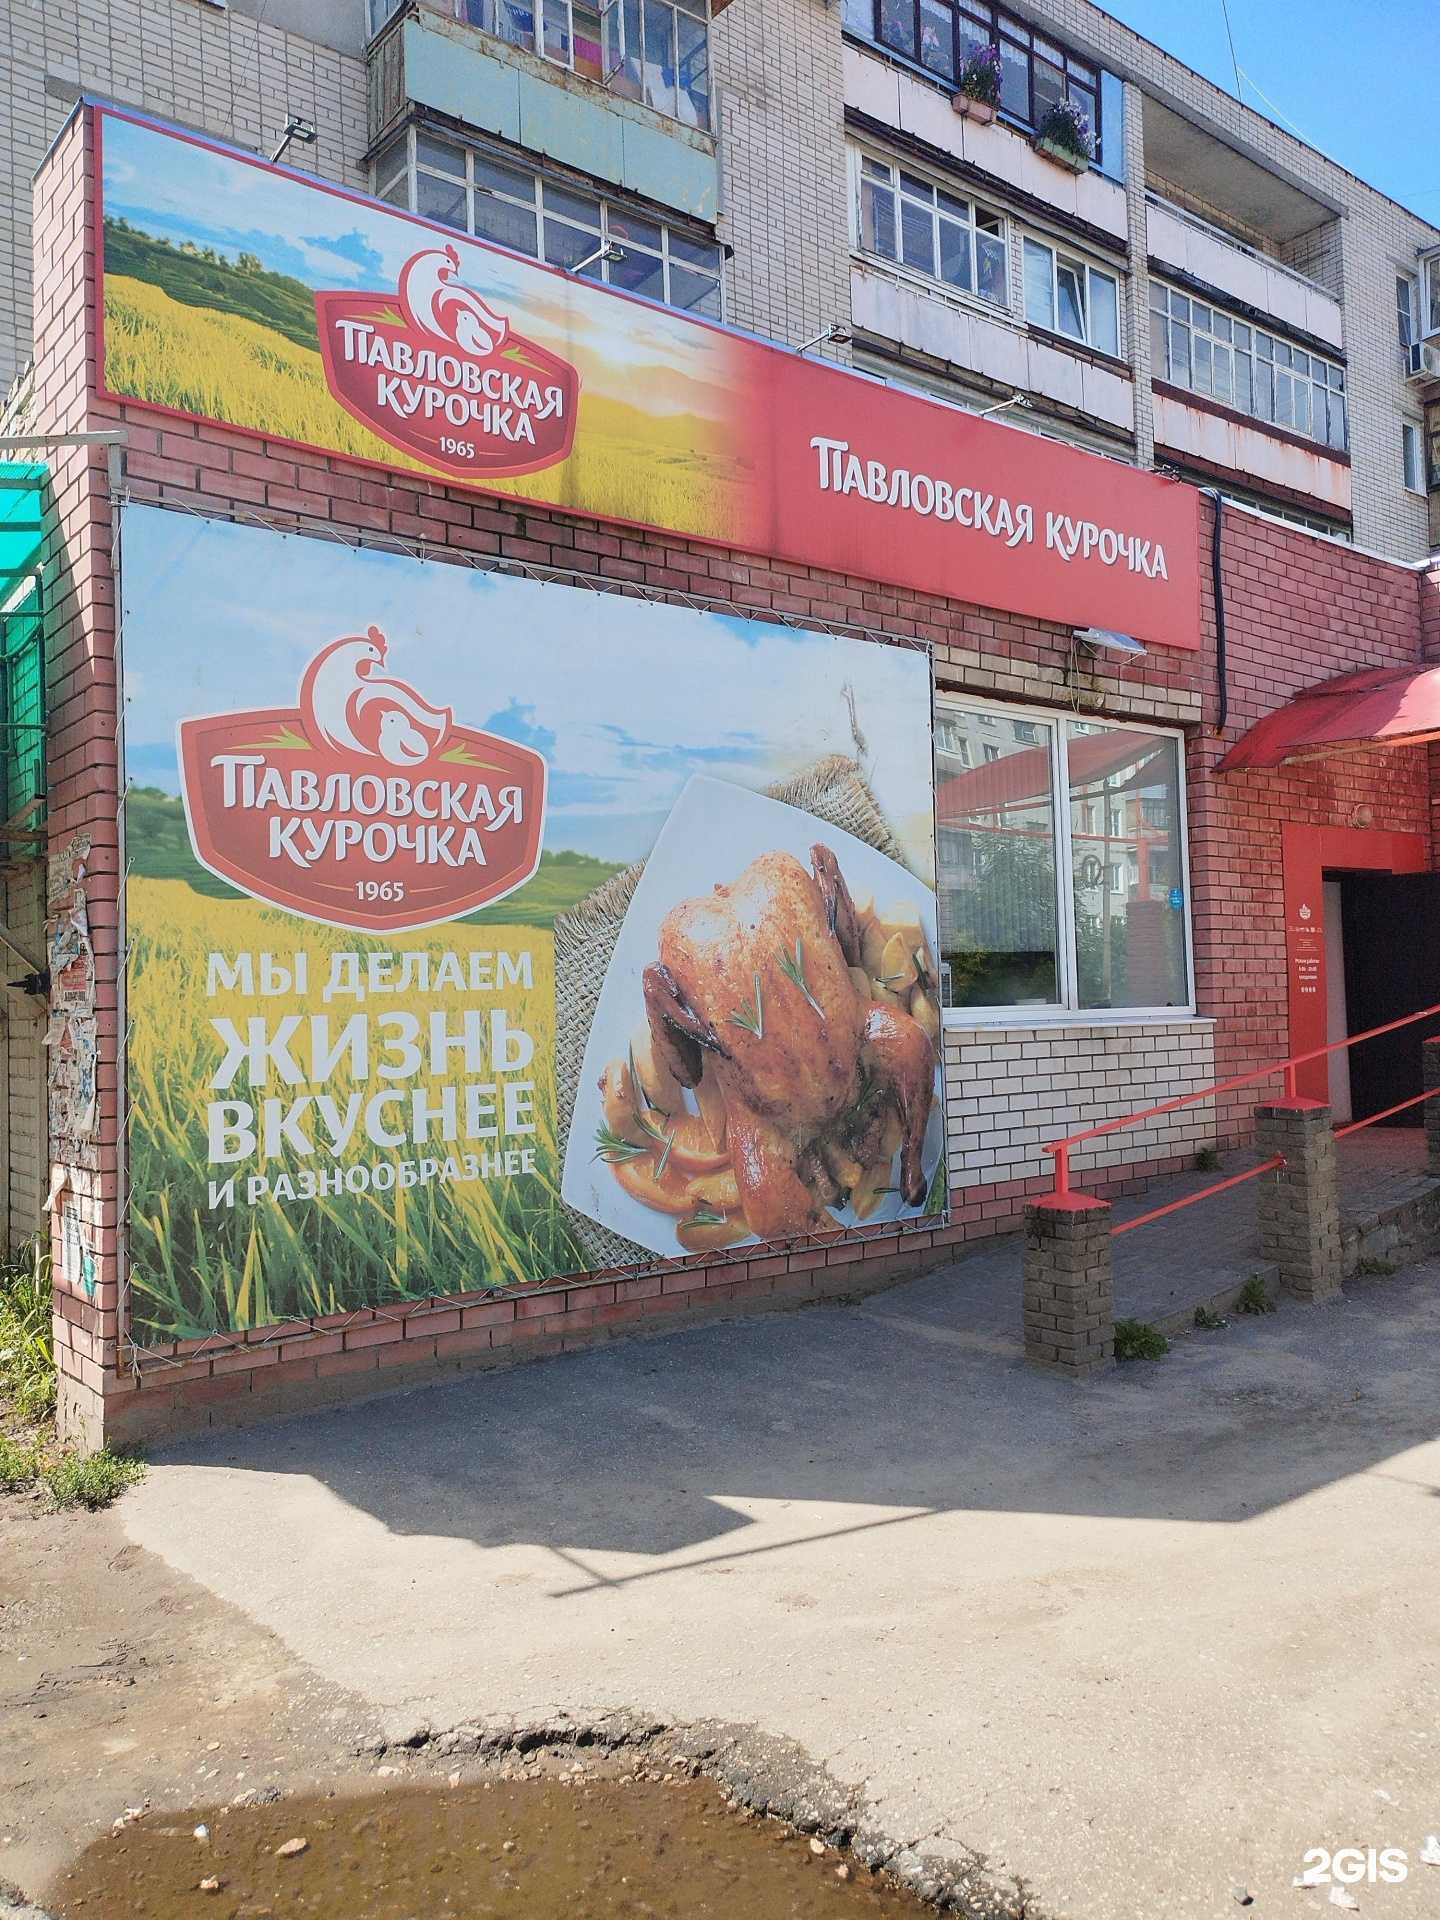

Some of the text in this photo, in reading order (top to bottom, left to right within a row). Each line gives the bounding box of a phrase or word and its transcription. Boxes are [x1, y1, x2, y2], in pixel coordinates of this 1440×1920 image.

[336, 319, 564, 420] ПАВЛОВСКАЯ
[377, 373, 536, 445] КУРОЧКА
[439, 436, 475, 459] 1965
[810, 437, 1168, 580] ПАВЛОВСКАЯ КУРОЧКА
[210, 754, 523, 832] ПАВЛОВСКАЯ
[269, 816, 488, 869] КУРОЧКА
[355, 881, 405, 902] 1965
[206, 951, 534, 1003] МЫ ДЕЛАЕМ
[208, 1008, 535, 1090] ЖИЗНЬ
[207, 1081, 536, 1164] ВКУСНЕЕ
[208, 1149, 537, 1210] И РАЗНООБРАЗНЕЕ
